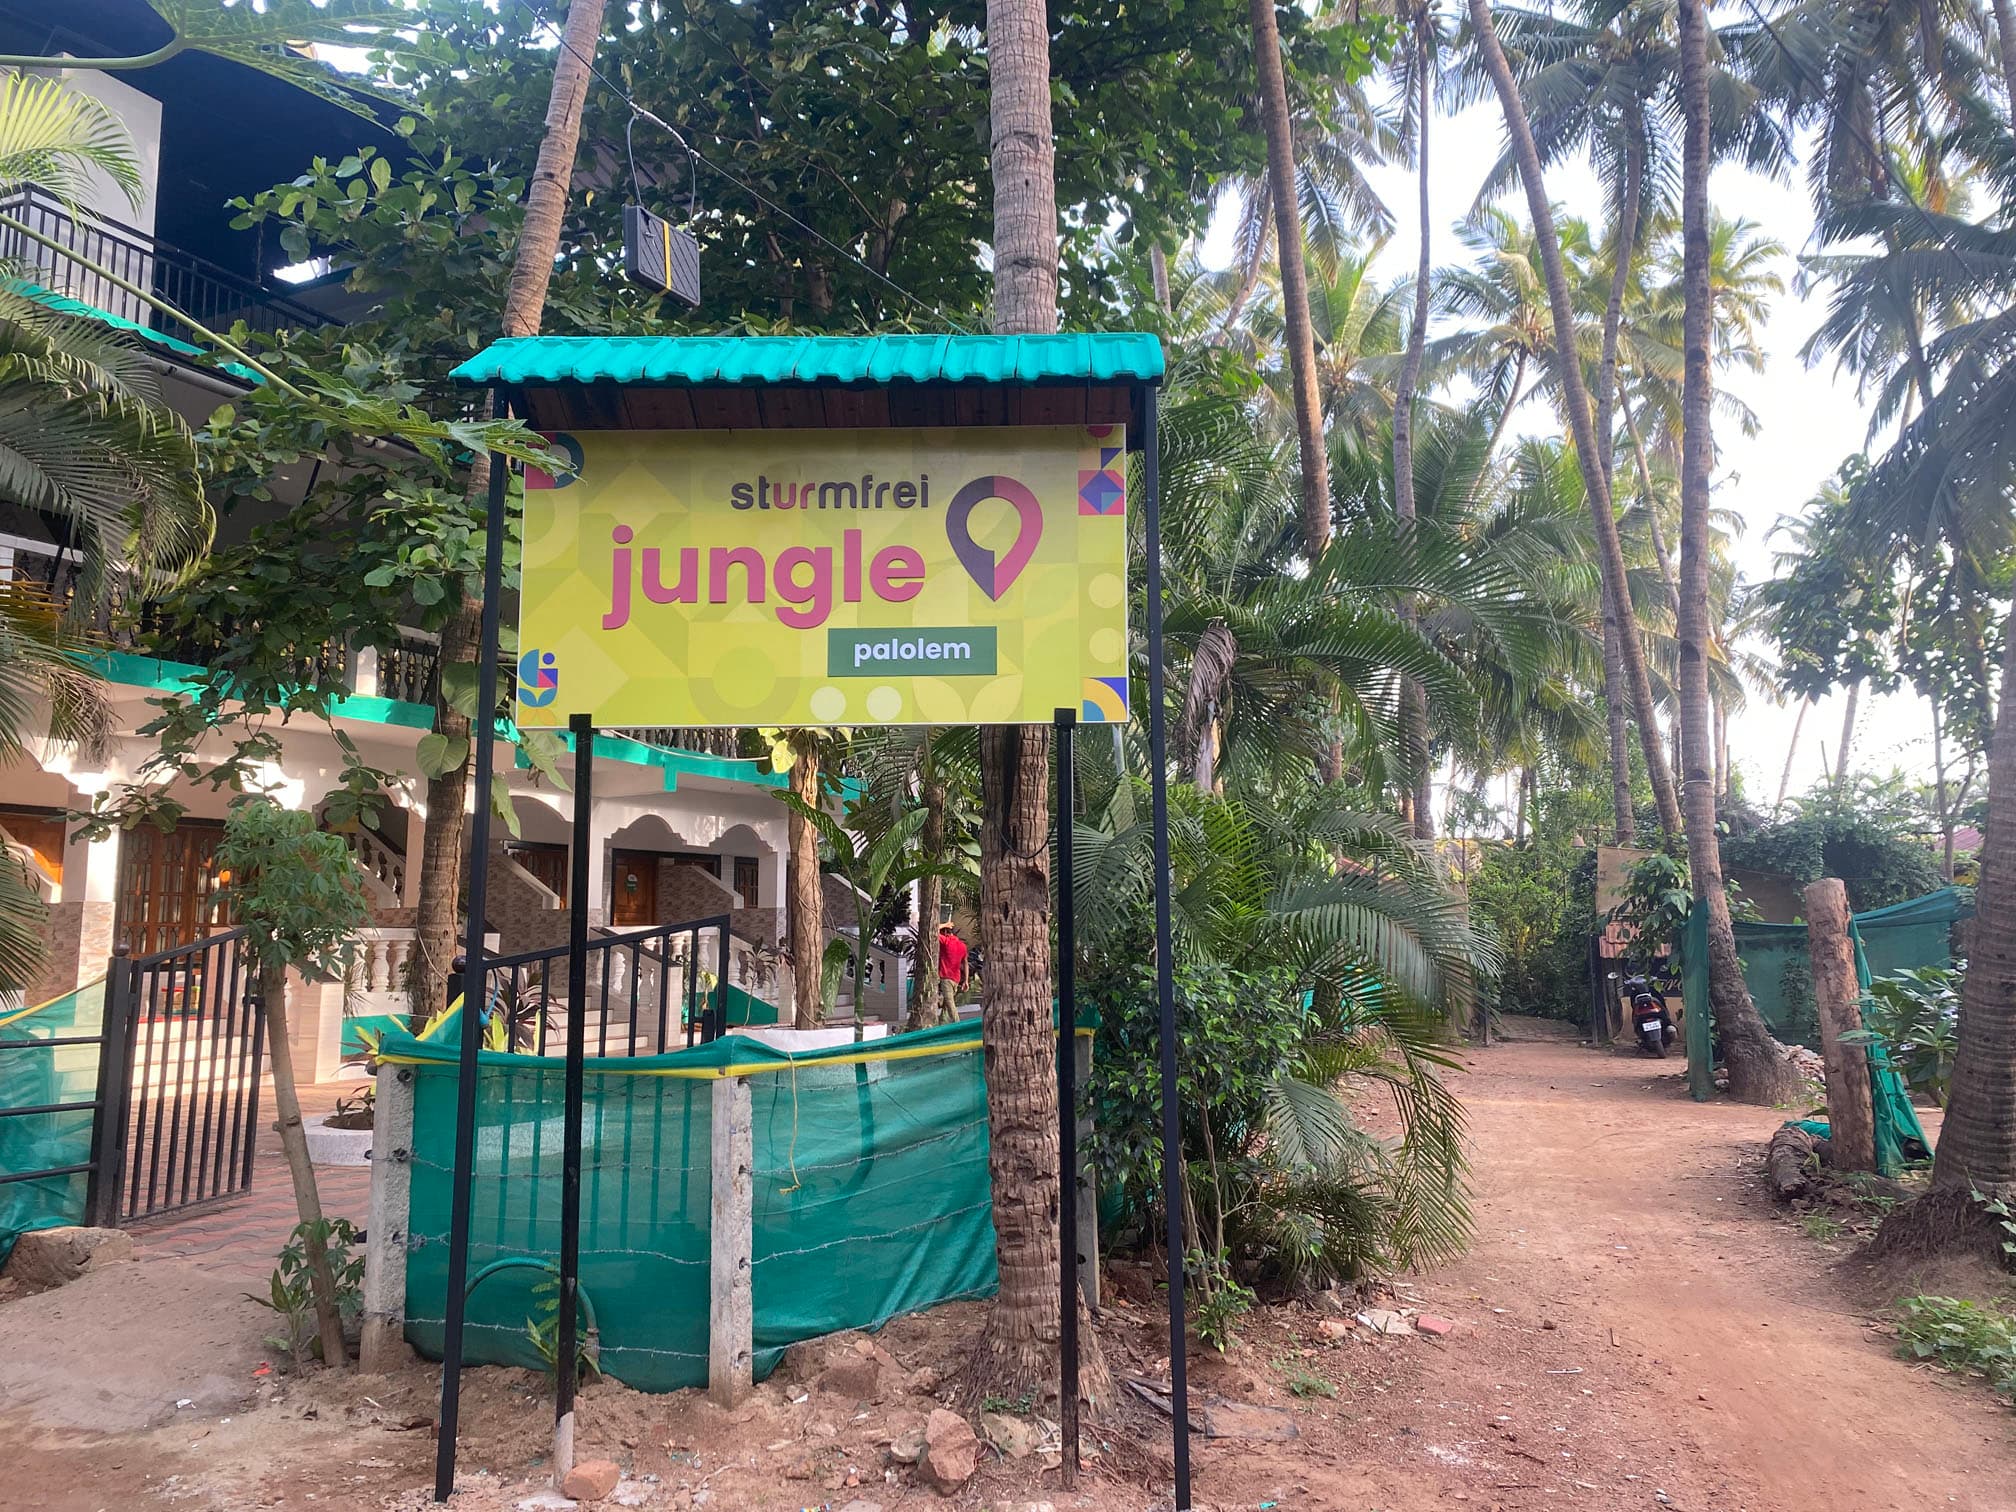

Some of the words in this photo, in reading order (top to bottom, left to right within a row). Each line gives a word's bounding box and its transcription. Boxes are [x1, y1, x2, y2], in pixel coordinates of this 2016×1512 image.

[731, 474, 929, 510] sturmfrei
[602, 525, 926, 630] jungle
[854, 638, 971, 667] palolem
